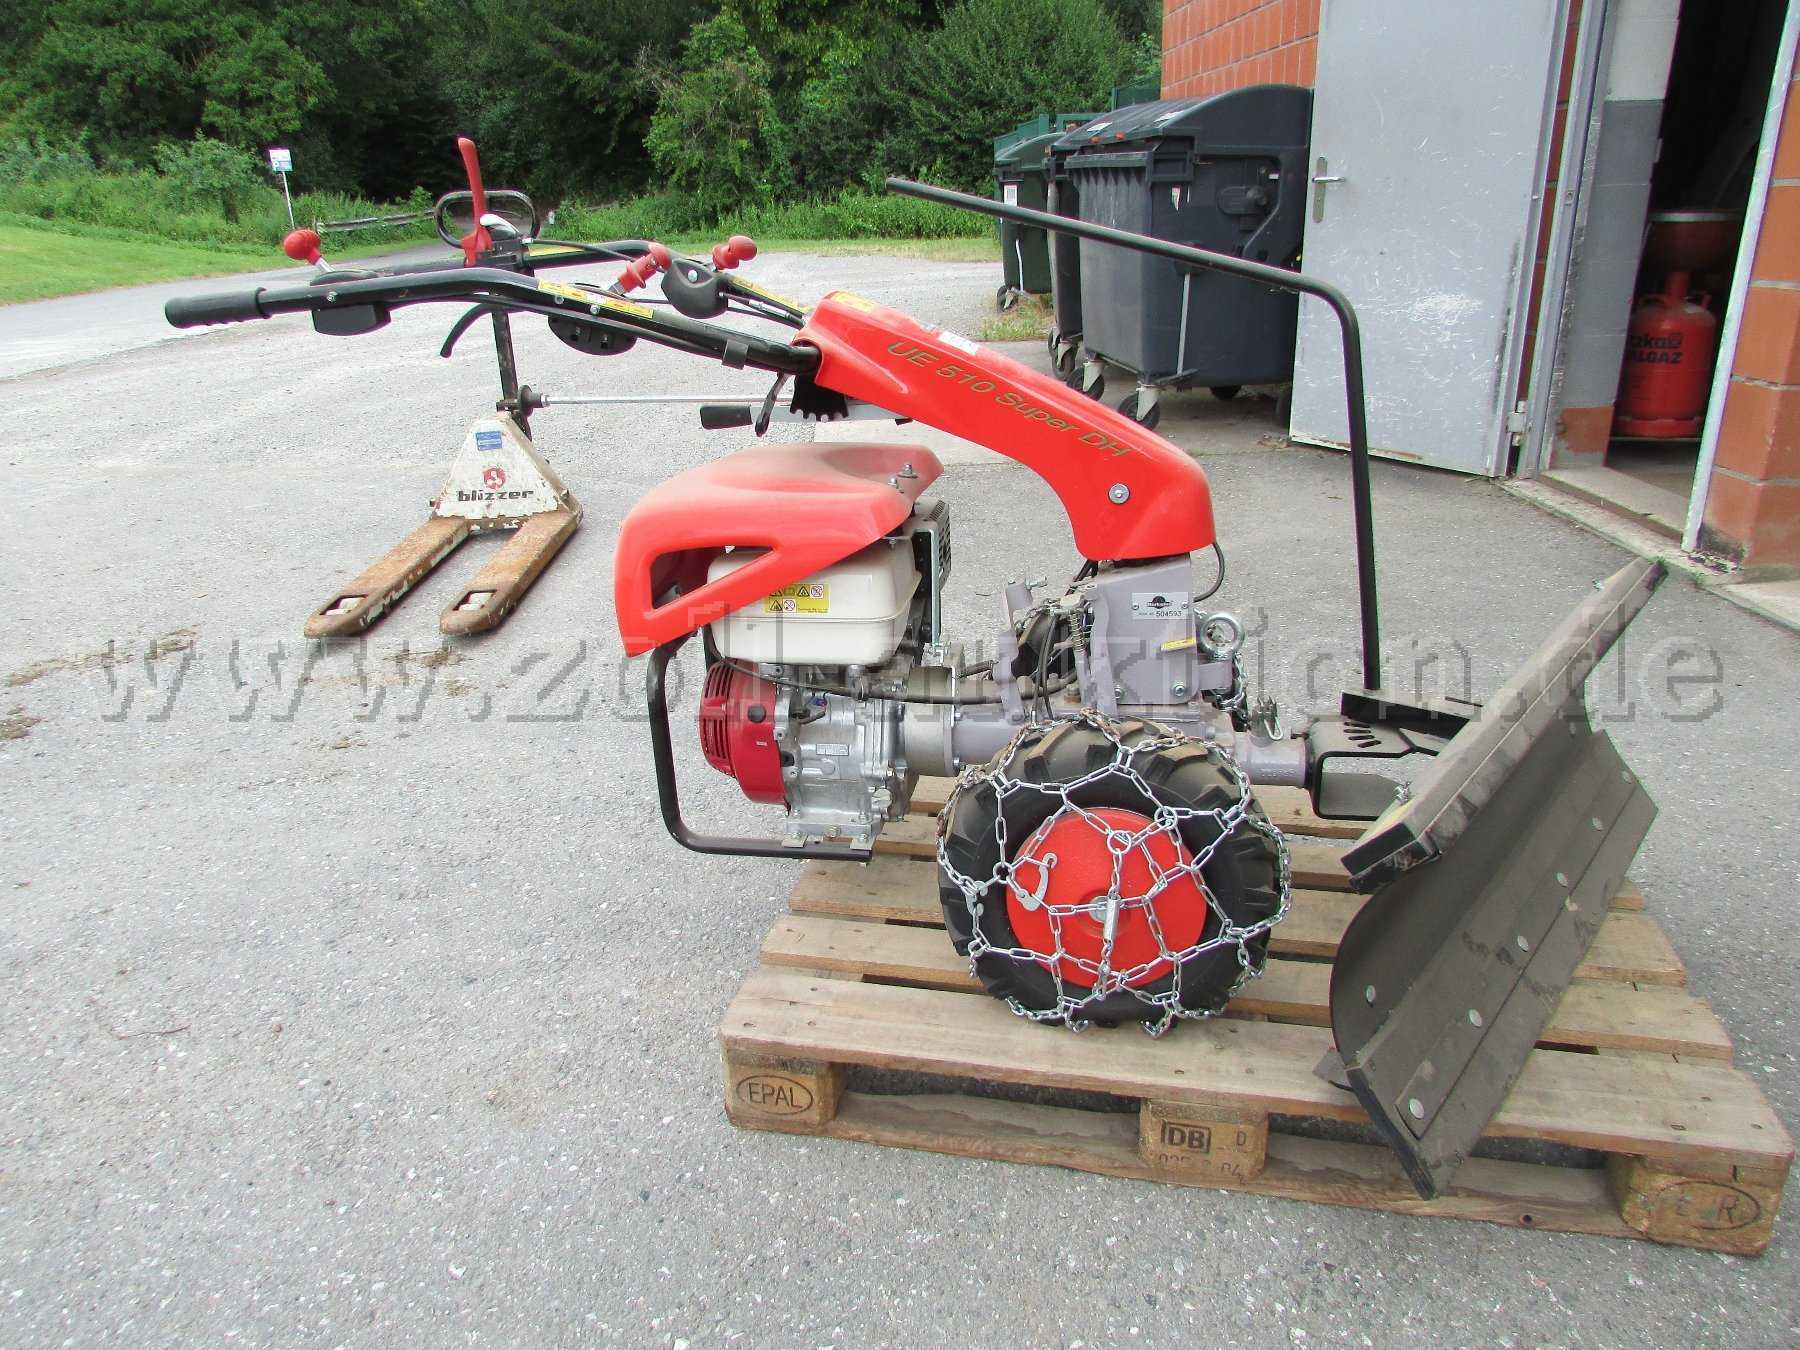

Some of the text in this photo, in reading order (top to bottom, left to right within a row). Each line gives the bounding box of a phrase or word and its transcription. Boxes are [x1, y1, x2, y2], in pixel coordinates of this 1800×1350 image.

[887, 341, 939, 368] UE
[935, 363, 998, 394] 510
[995, 391, 1080, 433] Super
[1077, 430, 1133, 458] DH
[458, 489, 534, 502] blizzer
[1155, 610, 1182, 618] 504593
[748, 1081, 803, 1109] EPAL
[1166, 1124, 1207, 1151] DB
